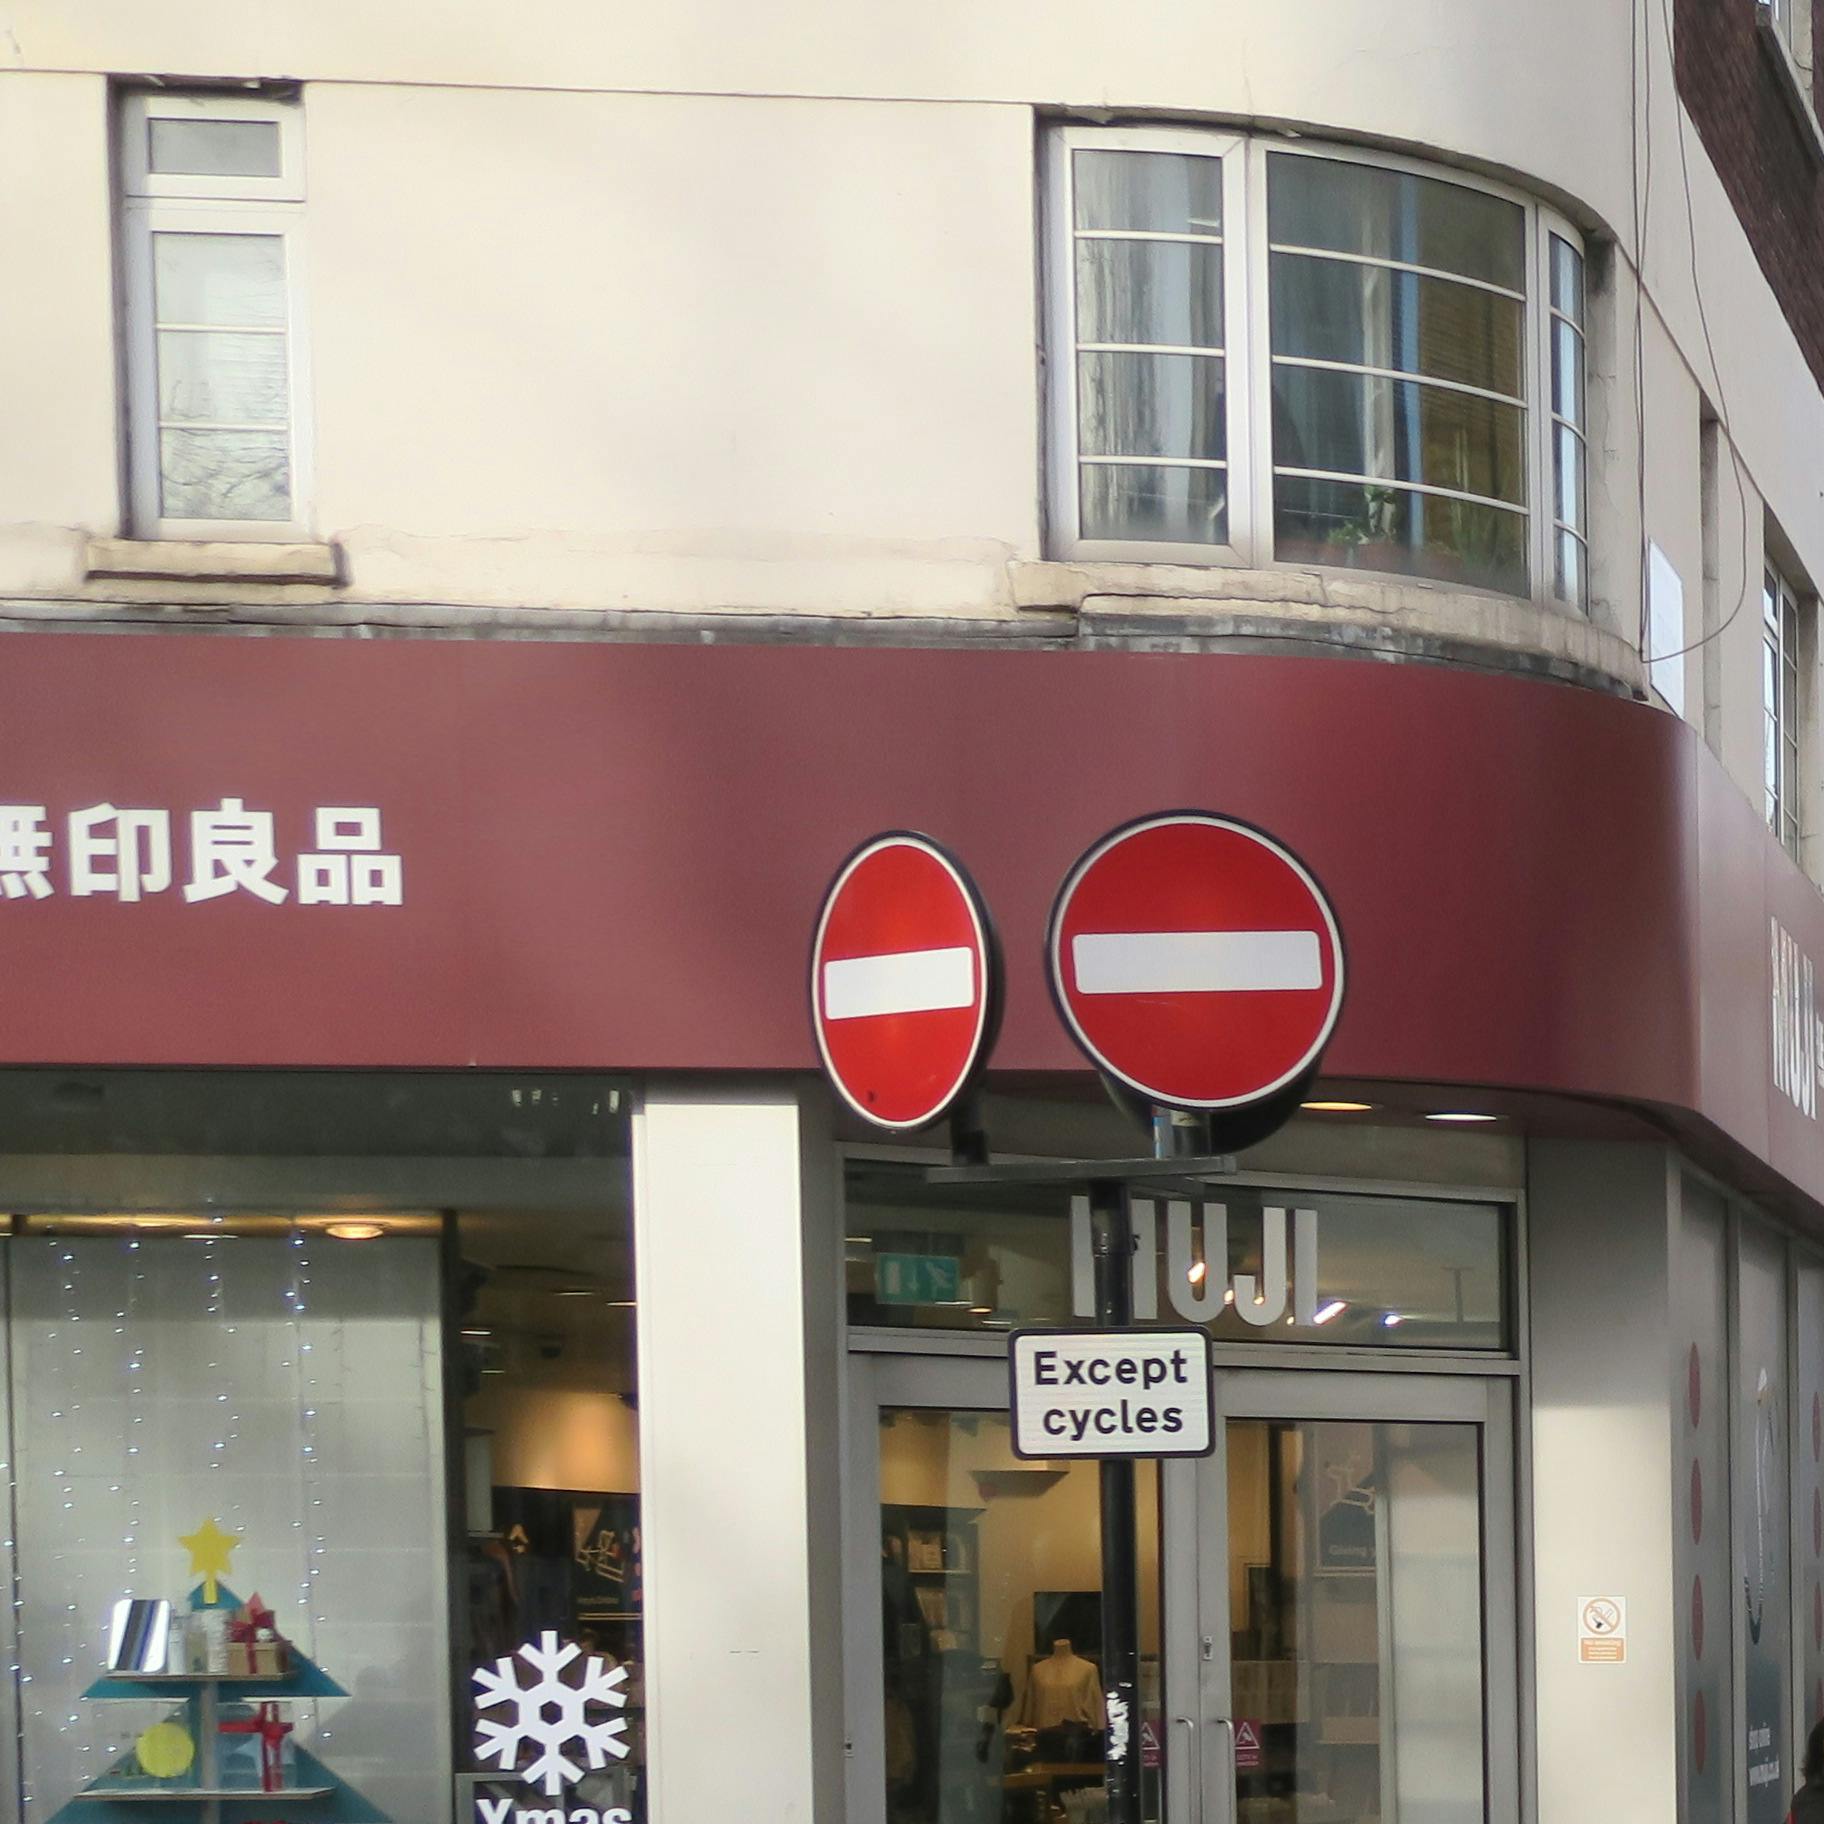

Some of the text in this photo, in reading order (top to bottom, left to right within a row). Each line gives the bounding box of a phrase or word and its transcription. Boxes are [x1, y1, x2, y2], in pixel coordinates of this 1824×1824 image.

[1771, 916, 1816, 1120] MUJI
[1034, 1349, 1188, 1390] Except
[1043, 1399, 1184, 1441] cycles
